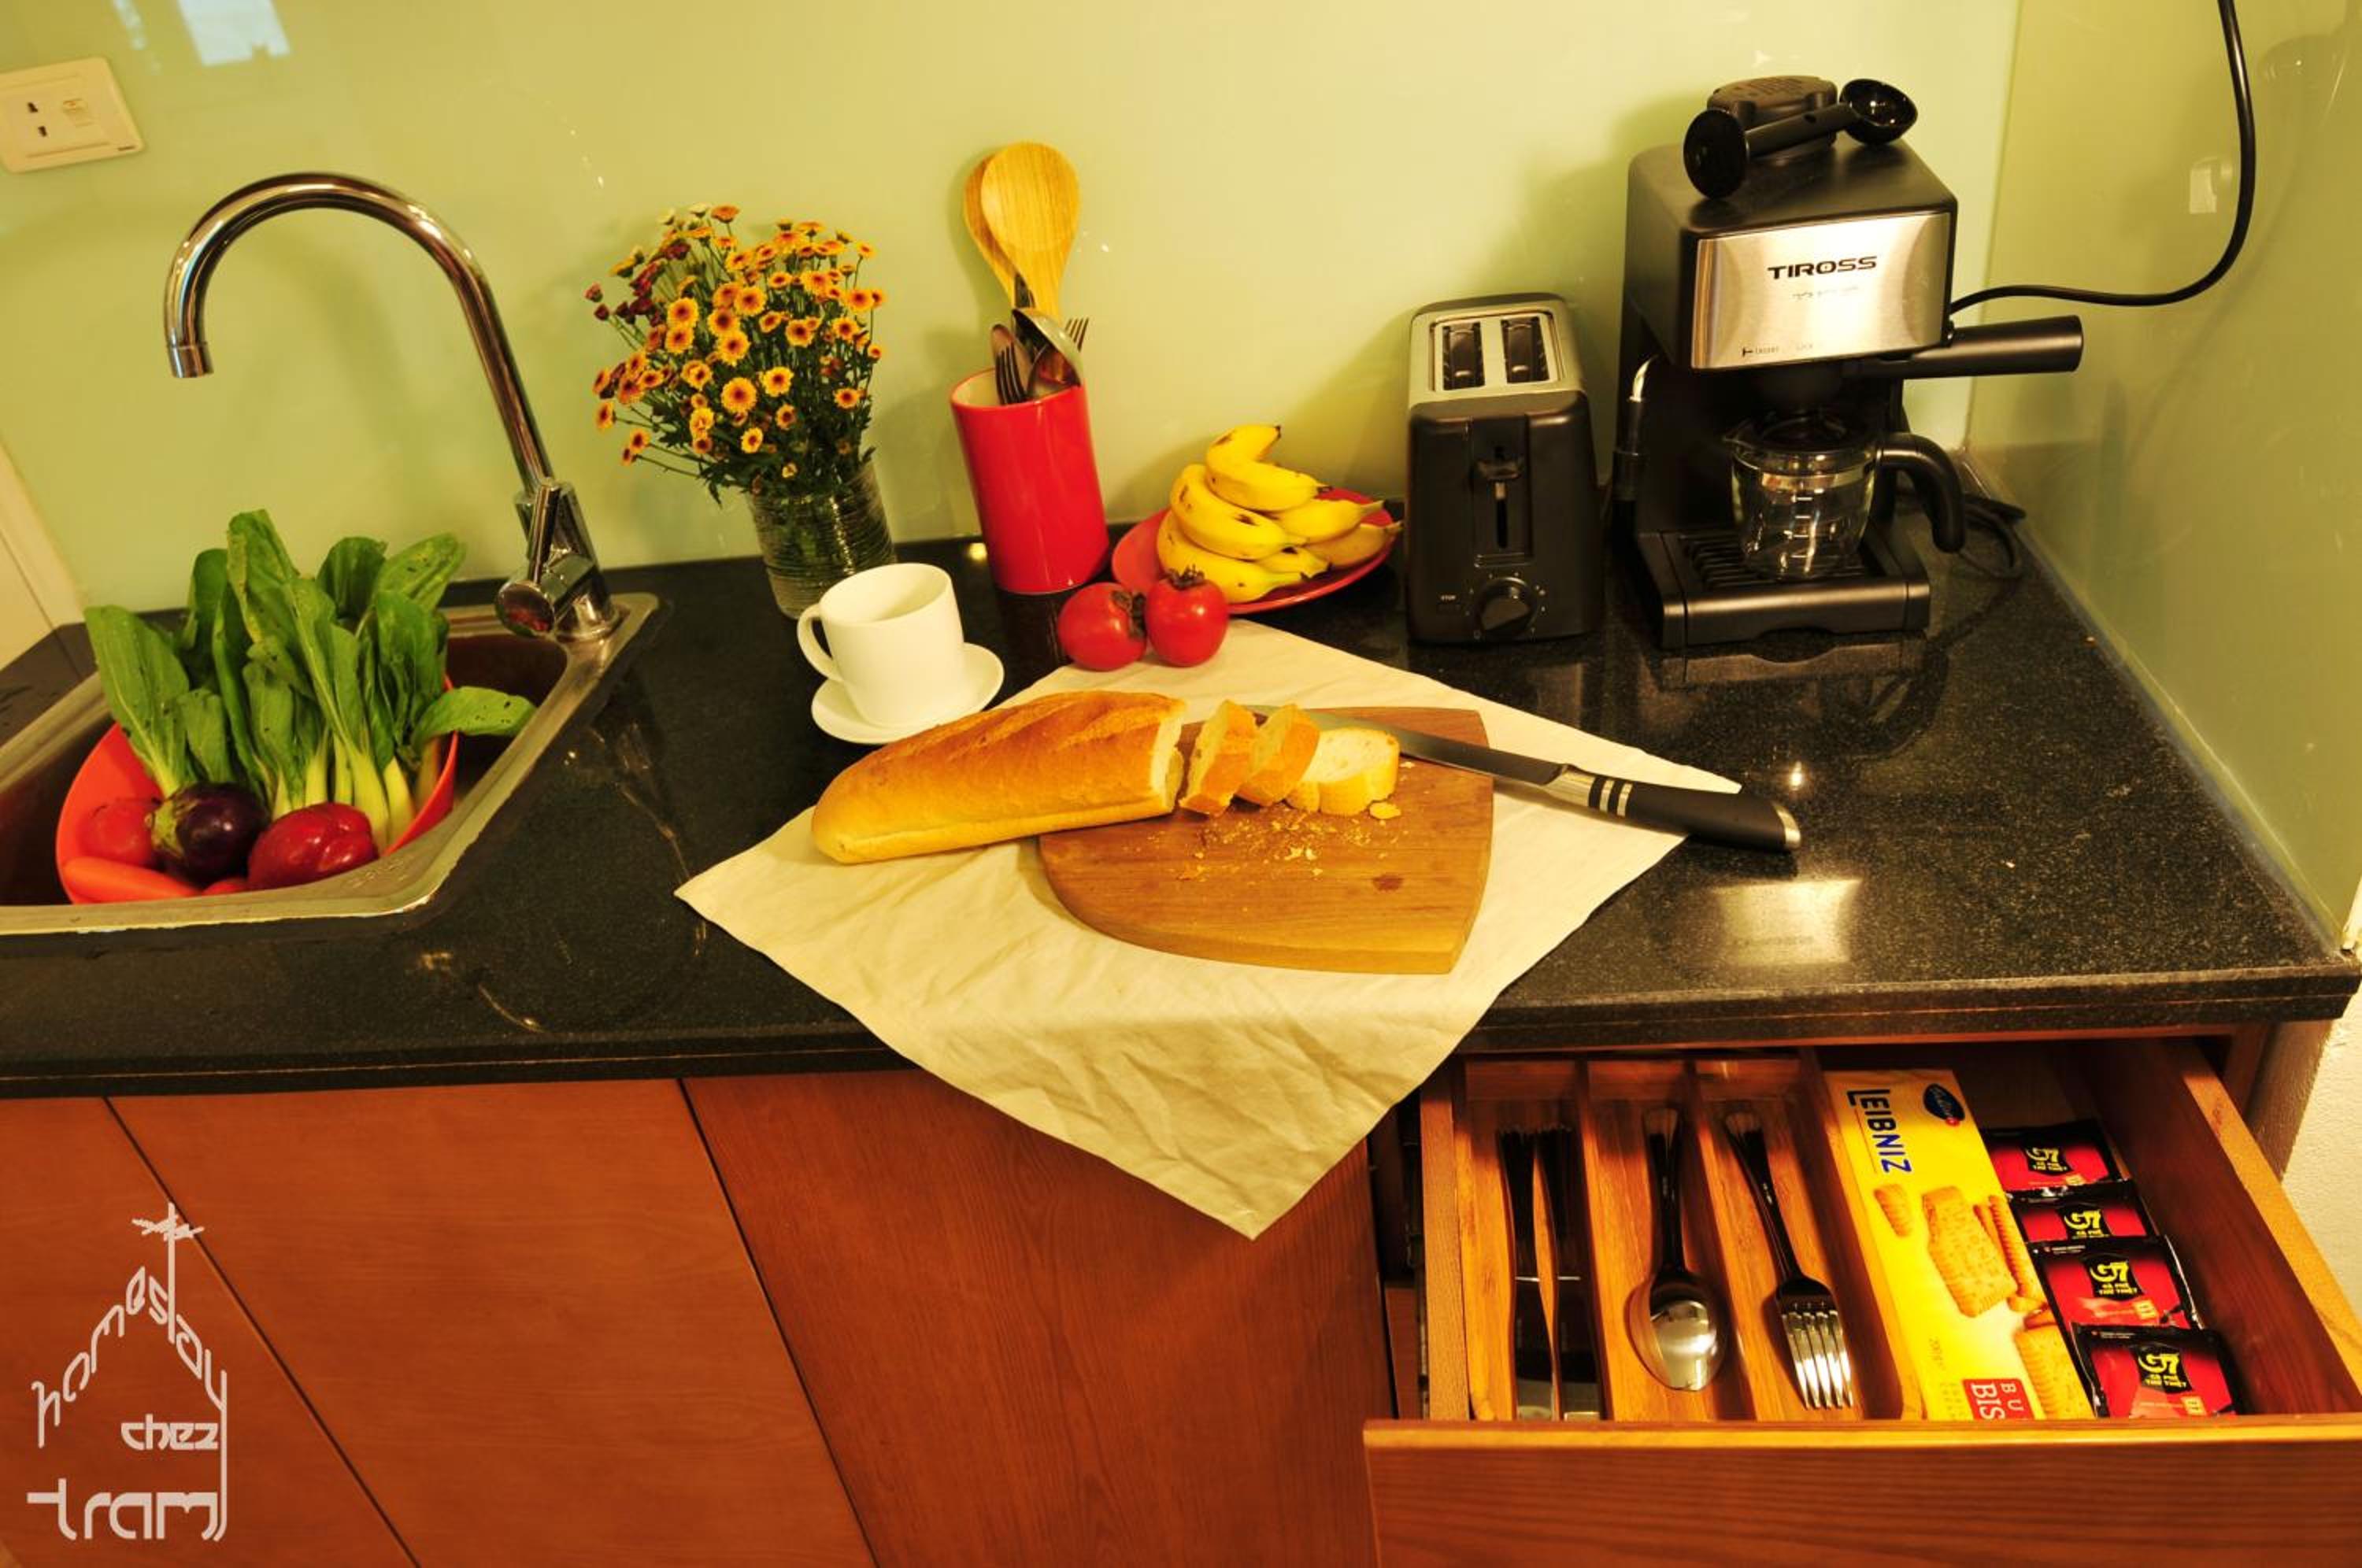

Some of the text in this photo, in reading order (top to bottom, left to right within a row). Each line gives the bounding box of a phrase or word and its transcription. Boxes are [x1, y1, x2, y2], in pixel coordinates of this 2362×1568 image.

[1768, 256, 1877, 279] TIROSS
[1846, 1089, 1912, 1173] LEIBNIZ
[2064, 1209, 2101, 1230] G7
[2090, 1261, 2129, 1282] G7
[2138, 1352, 2181, 1374] G7
